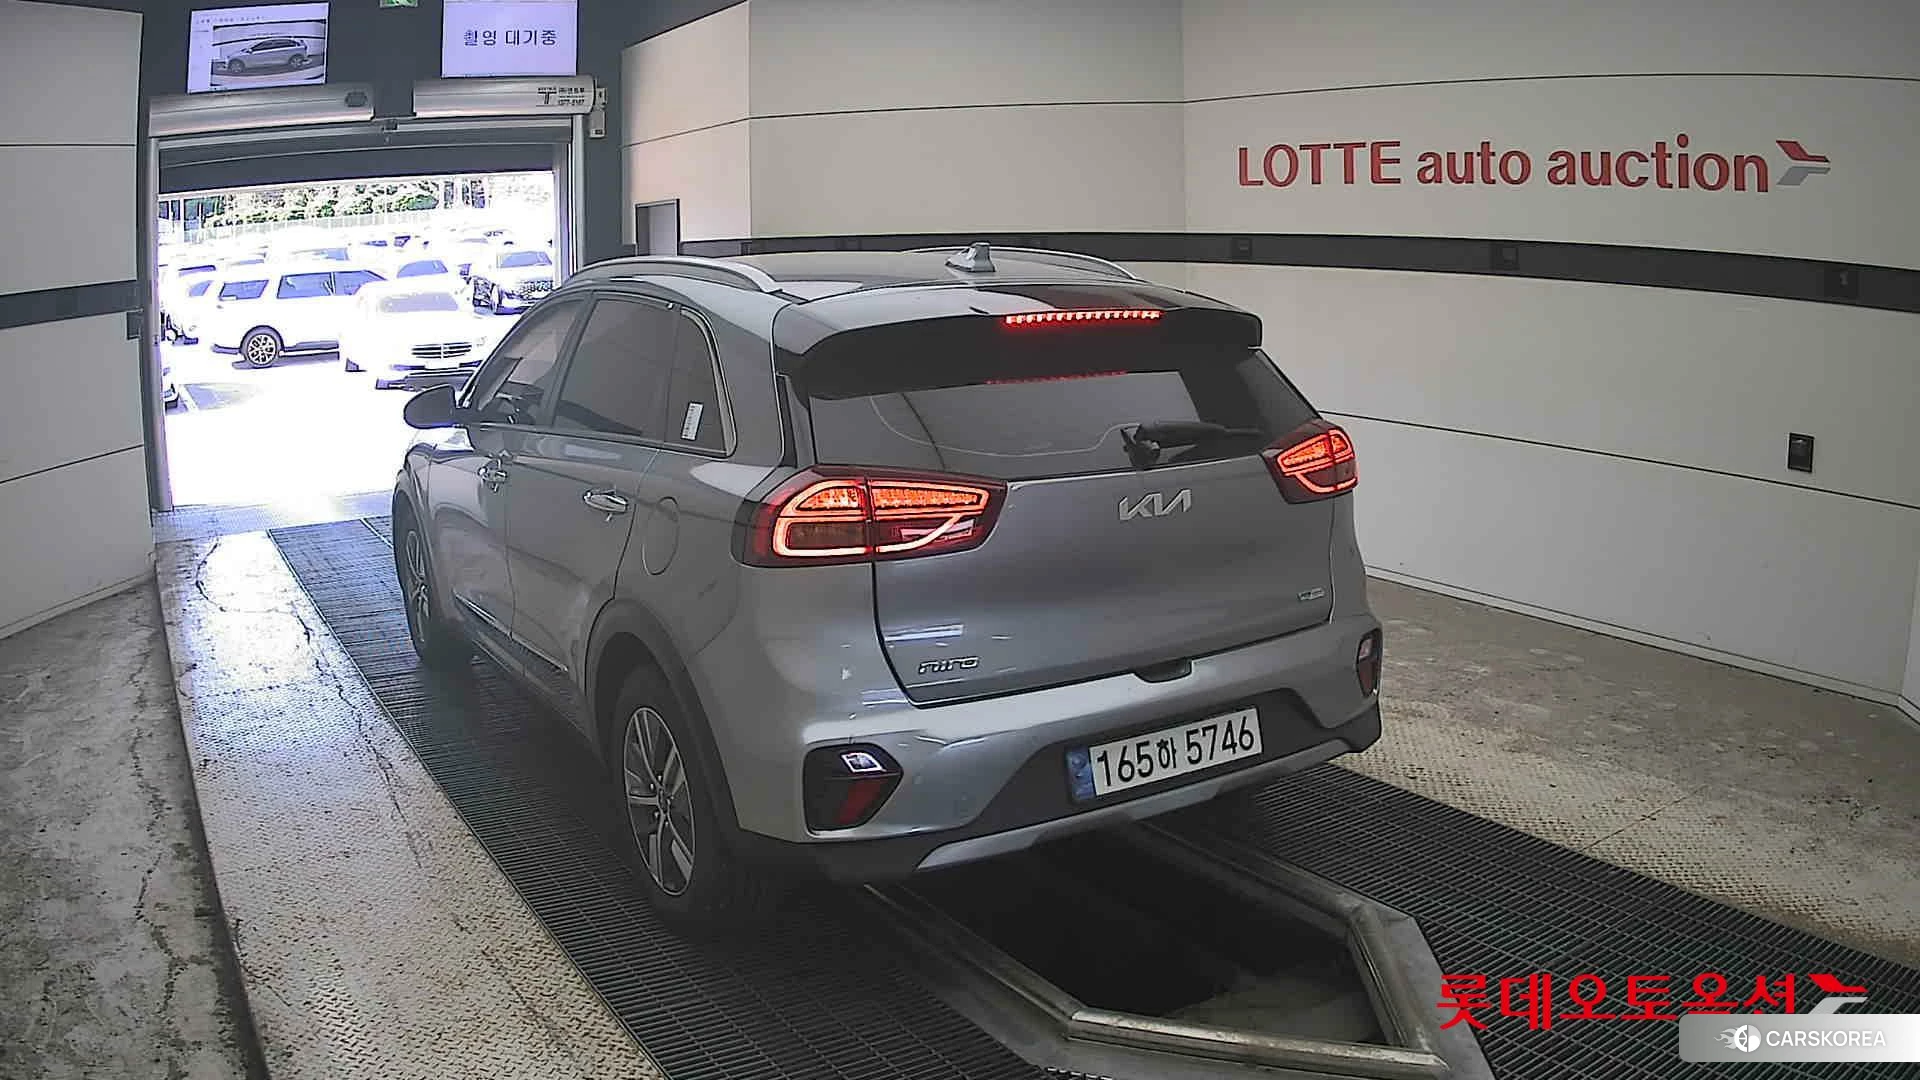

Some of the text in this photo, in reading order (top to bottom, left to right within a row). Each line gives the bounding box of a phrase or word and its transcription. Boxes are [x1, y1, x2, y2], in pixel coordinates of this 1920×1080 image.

[505, 29, 558, 46] 대기중
[1238, 133, 1769, 193] LOTTE auto auction
[1119, 488, 1191, 520] KIA
[1097, 715, 1255, 787] 165하 5746
